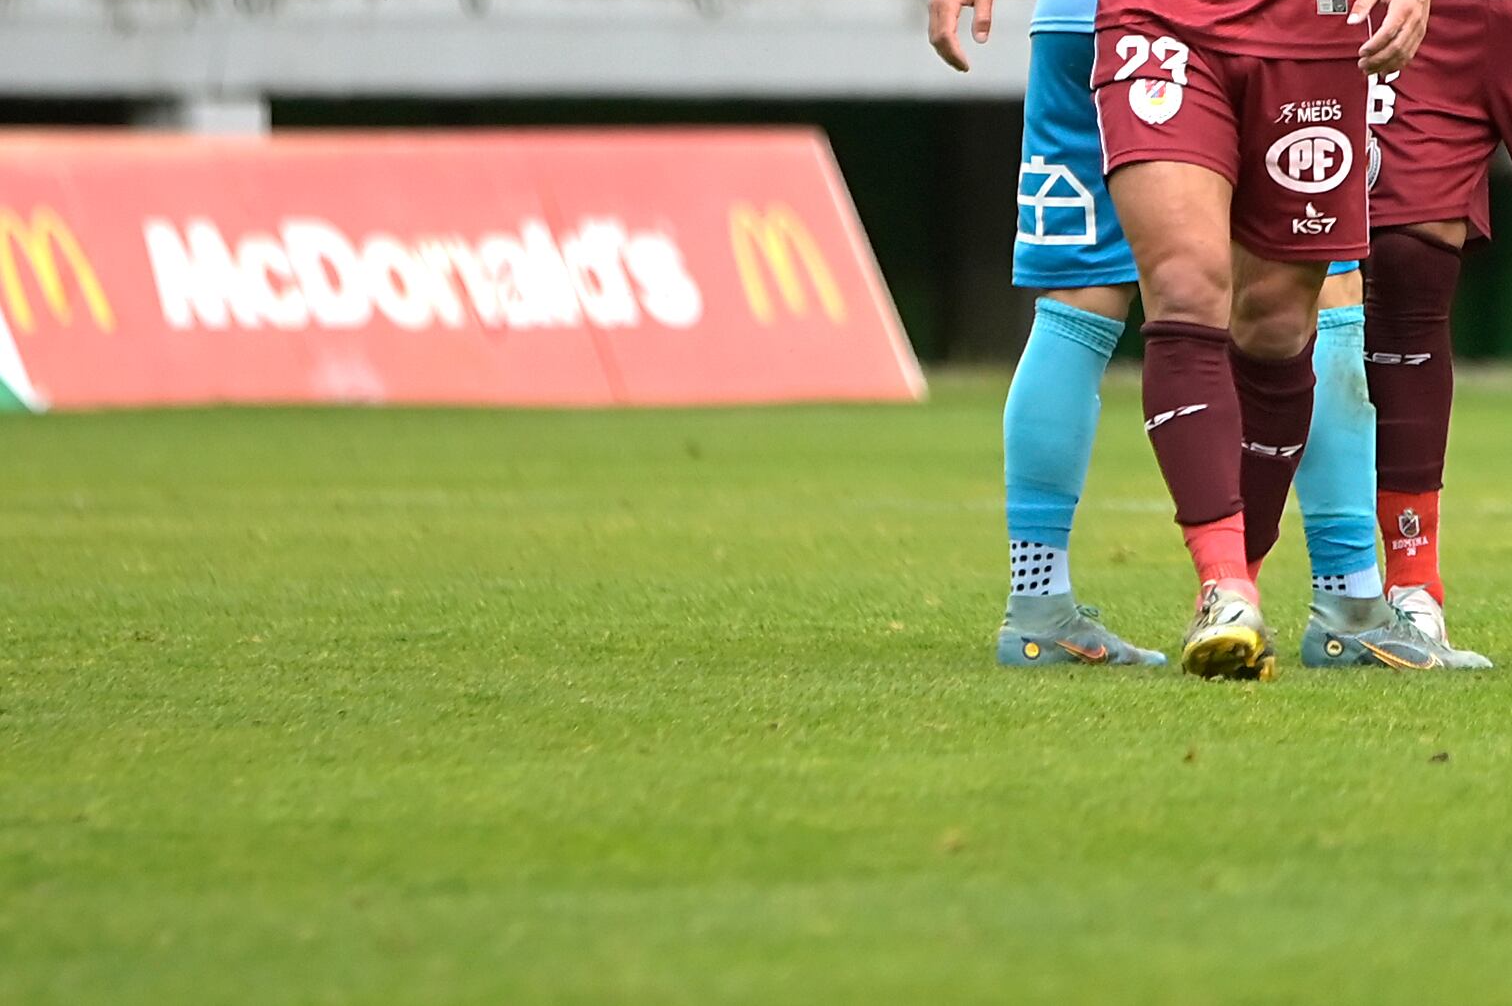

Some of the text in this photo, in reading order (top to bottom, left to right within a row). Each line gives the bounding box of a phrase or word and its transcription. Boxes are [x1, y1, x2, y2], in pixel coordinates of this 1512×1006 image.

[1297, 104, 1342, 123] MEDS
[1288, 137, 1336, 182] PF
[1292, 216, 1337, 234] KS7
[143, 216, 703, 329] McDonald's
